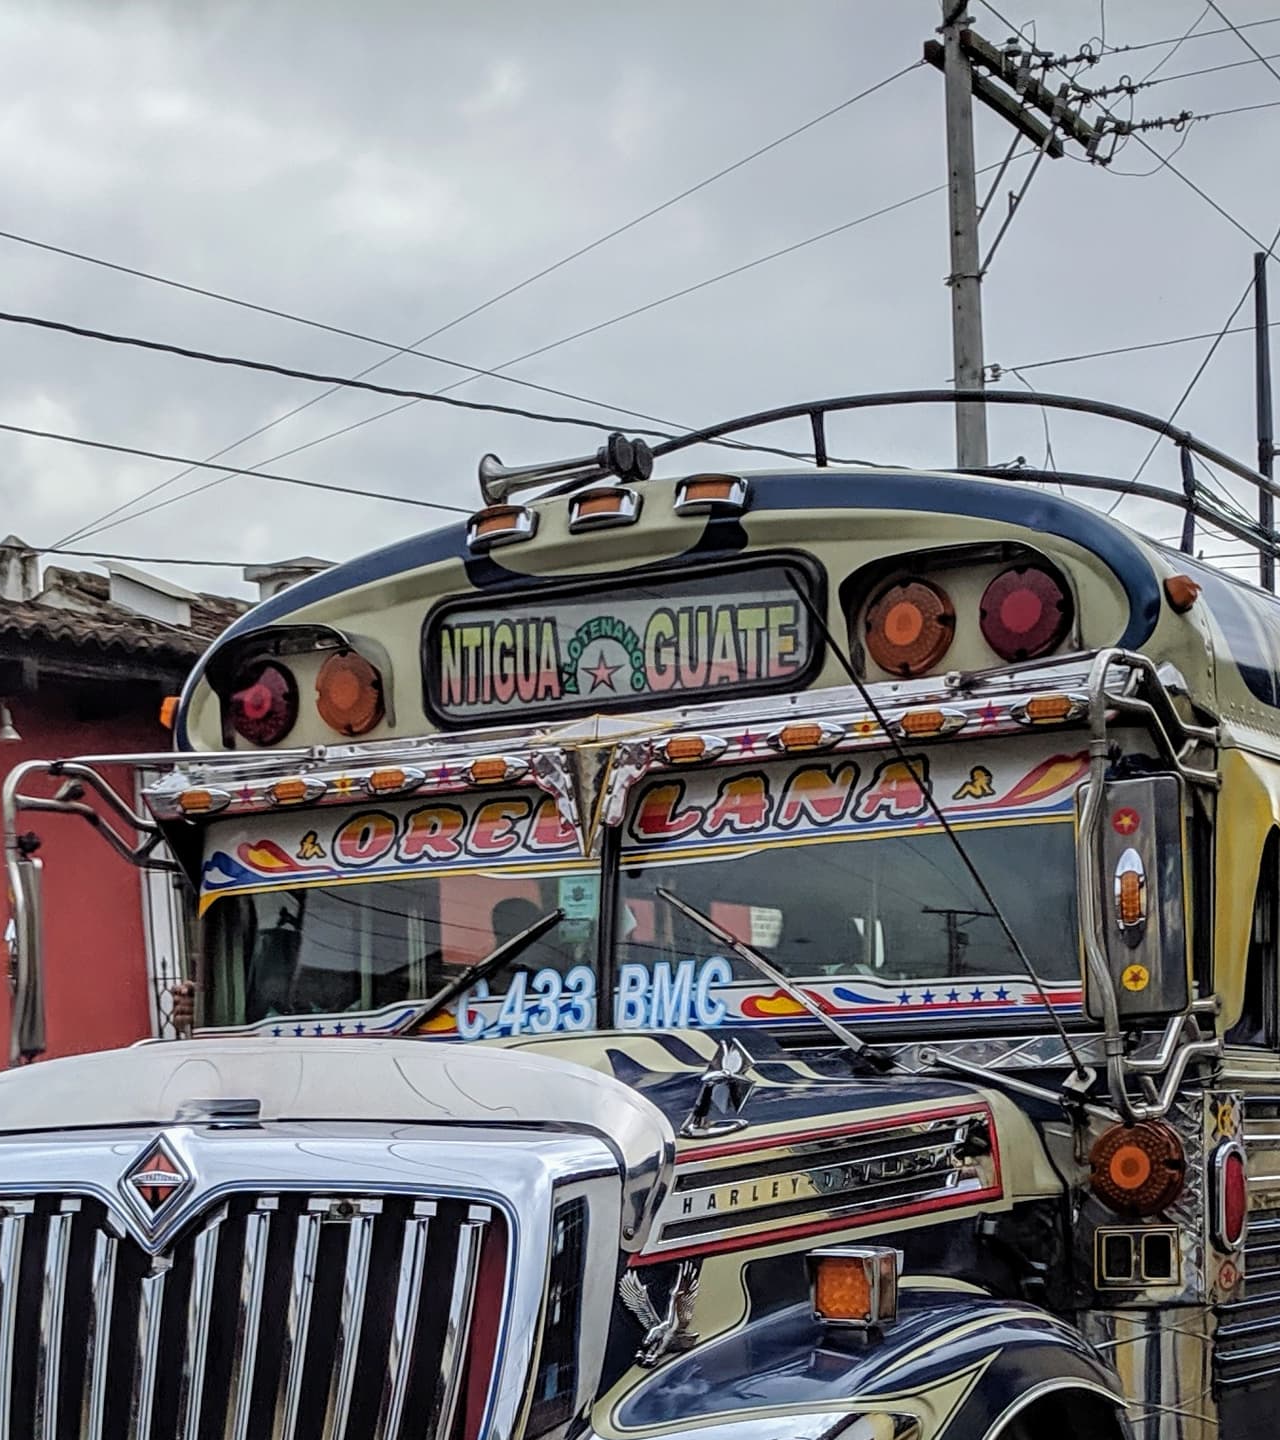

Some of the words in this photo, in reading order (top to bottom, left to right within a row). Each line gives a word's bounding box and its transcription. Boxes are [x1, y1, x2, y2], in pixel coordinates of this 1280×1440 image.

[562, 615, 646, 695] ALOTENANGO
[644, 601, 802, 693] GUATE
[456, 976, 490, 1041] C
[496, 965, 598, 1039] 433
[615, 956, 734, 1030] BMC
